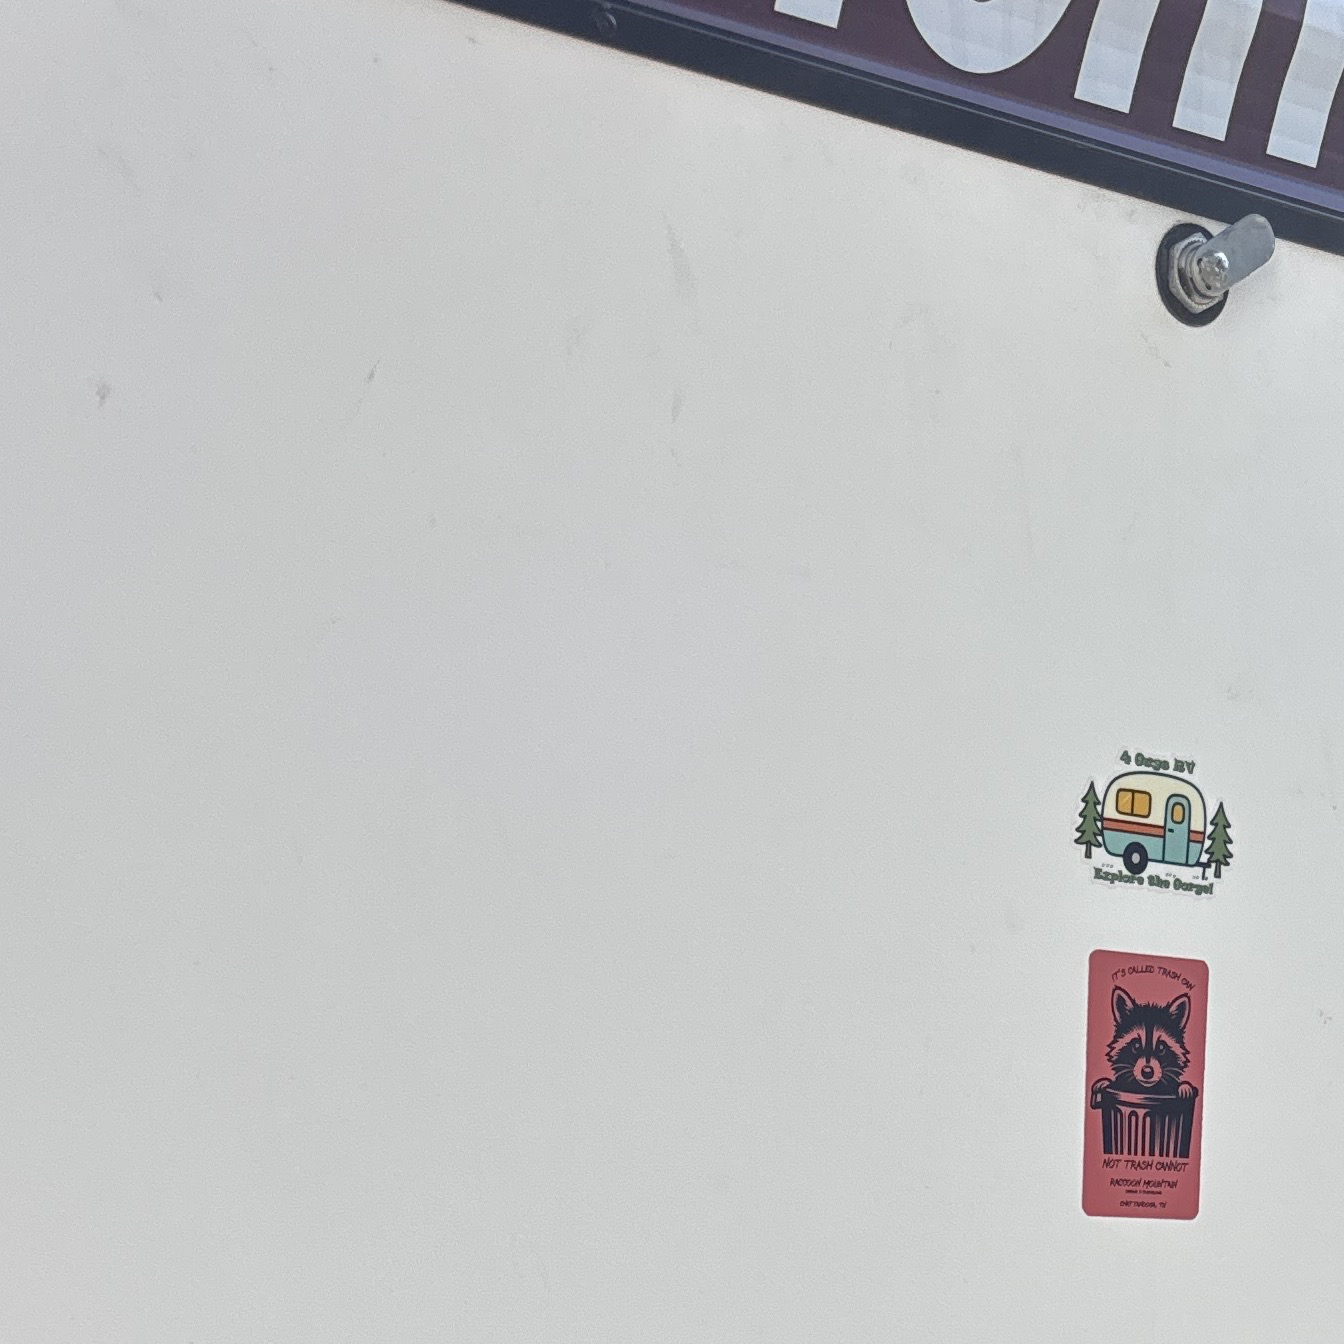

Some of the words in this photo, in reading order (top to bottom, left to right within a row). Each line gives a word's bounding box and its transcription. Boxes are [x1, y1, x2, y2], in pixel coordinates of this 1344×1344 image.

[1120, 750, 1131, 765] 4
[1173, 758, 1196, 774] RV
[1093, 867, 1144, 885] Explore
[1128, 965, 1154, 975] CALLED
[1158, 967, 1181, 981] TRASH
[1181, 977, 1196, 991] CAN
[1102, 1157, 1121, 1169] NOT
[1124, 1159, 1154, 1171] TRASH
[1155, 1160, 1189, 1172] CANNOT
[1110, 1178, 1142, 1188] RACCOON
[1143, 1179, 1178, 1189] MOUNTAIN
